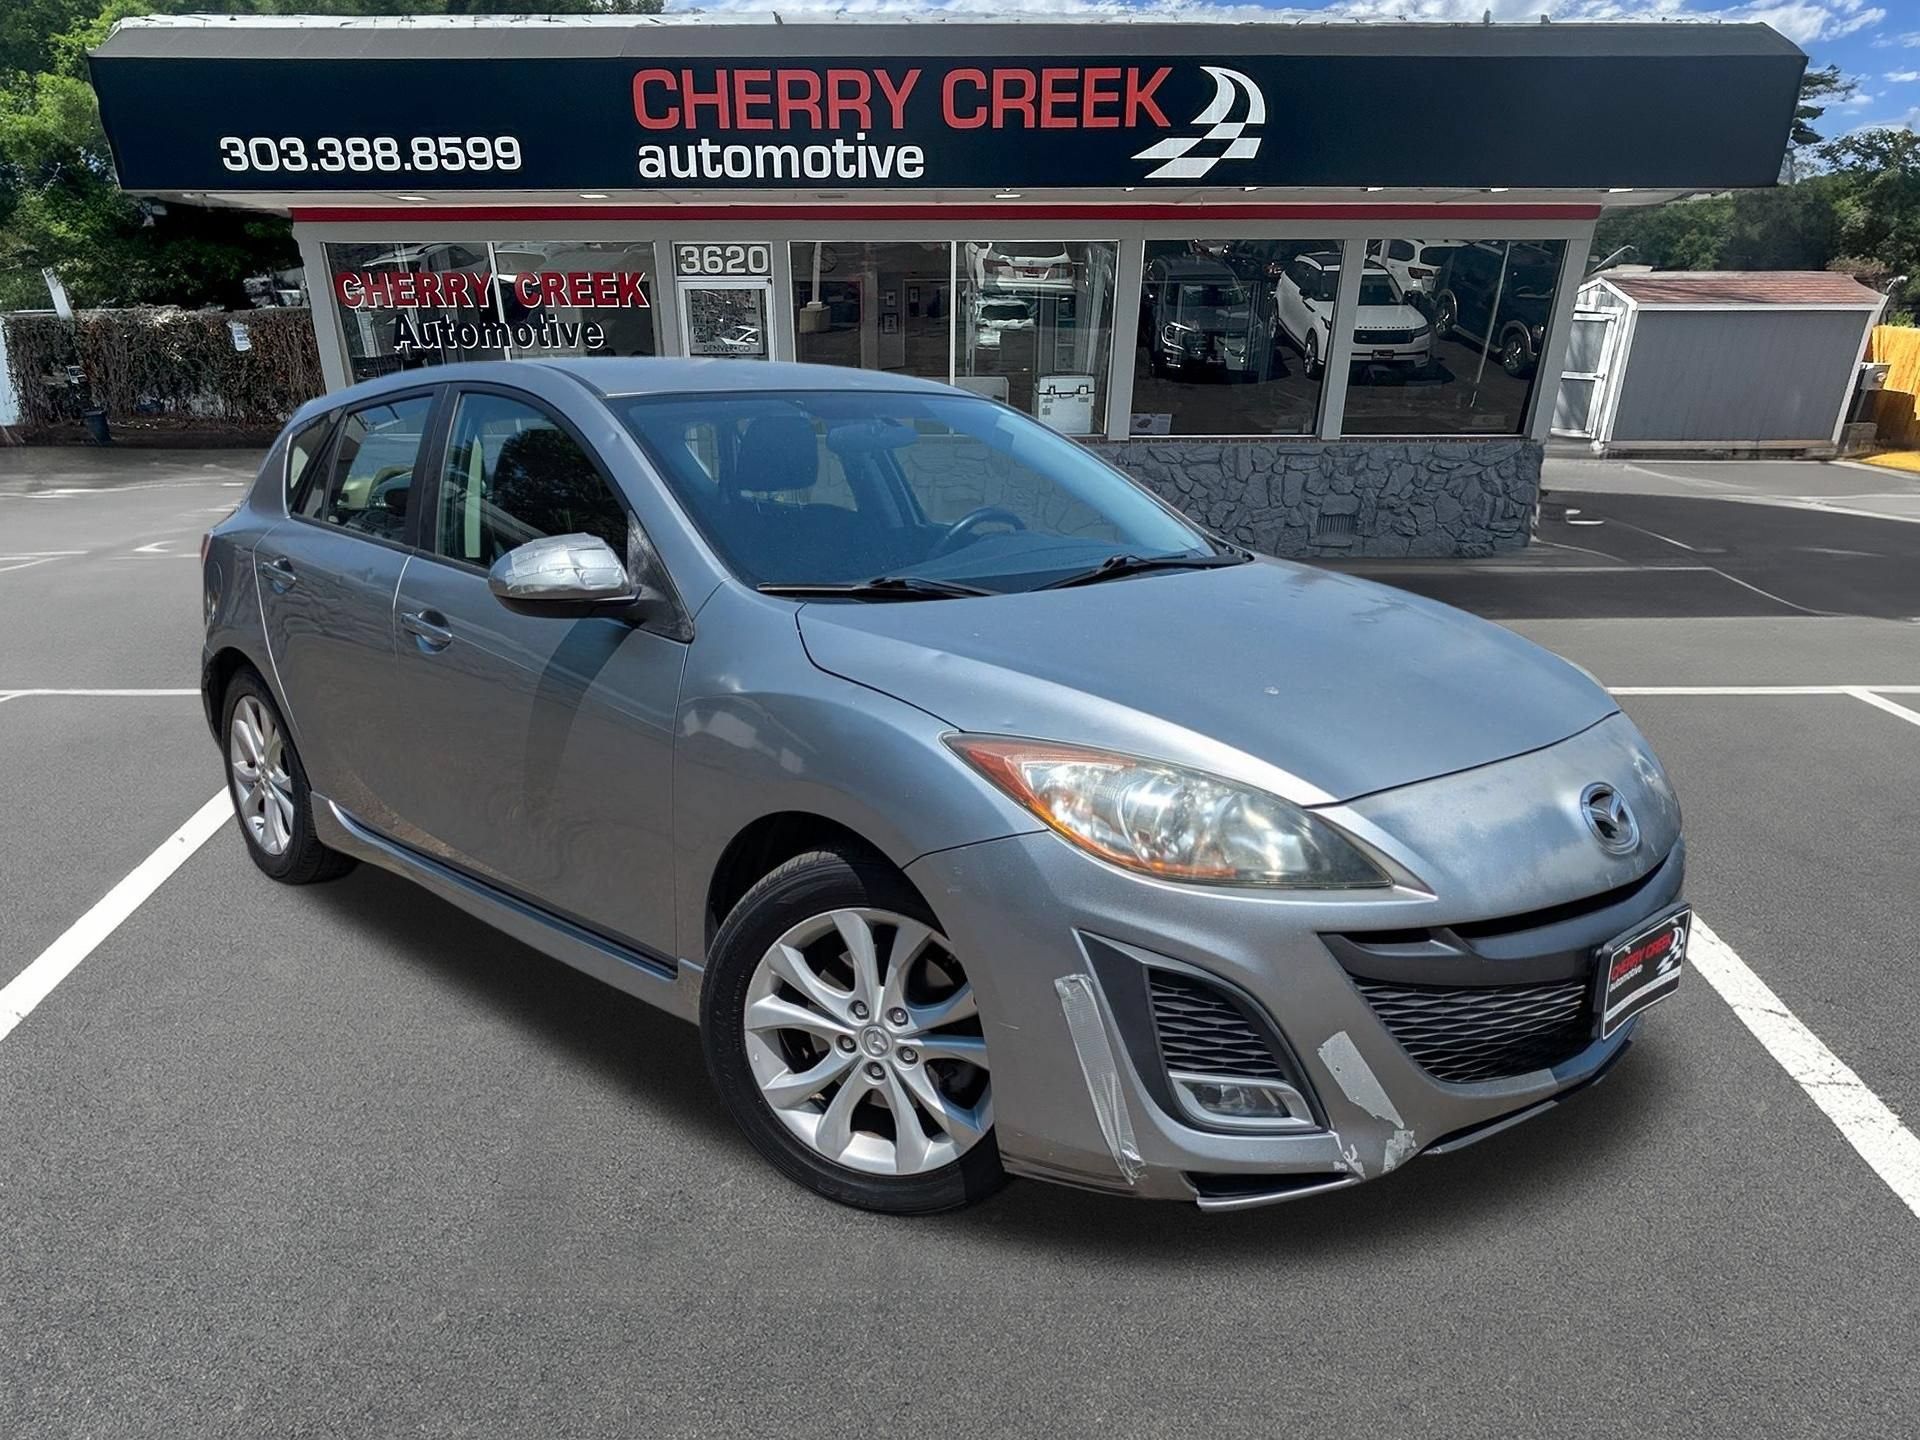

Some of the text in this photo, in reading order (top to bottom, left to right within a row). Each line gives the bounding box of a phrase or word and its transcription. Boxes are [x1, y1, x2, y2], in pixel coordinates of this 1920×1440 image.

[632, 67, 1173, 130] CHERRY CREEK
[219, 135, 522, 172] 303.388.8599
[638, 132, 925, 180] automotive
[680, 246, 769, 274] 3620
[334, 271, 650, 309] CHERRY CREEK
[393, 313, 605, 349] Automotive
